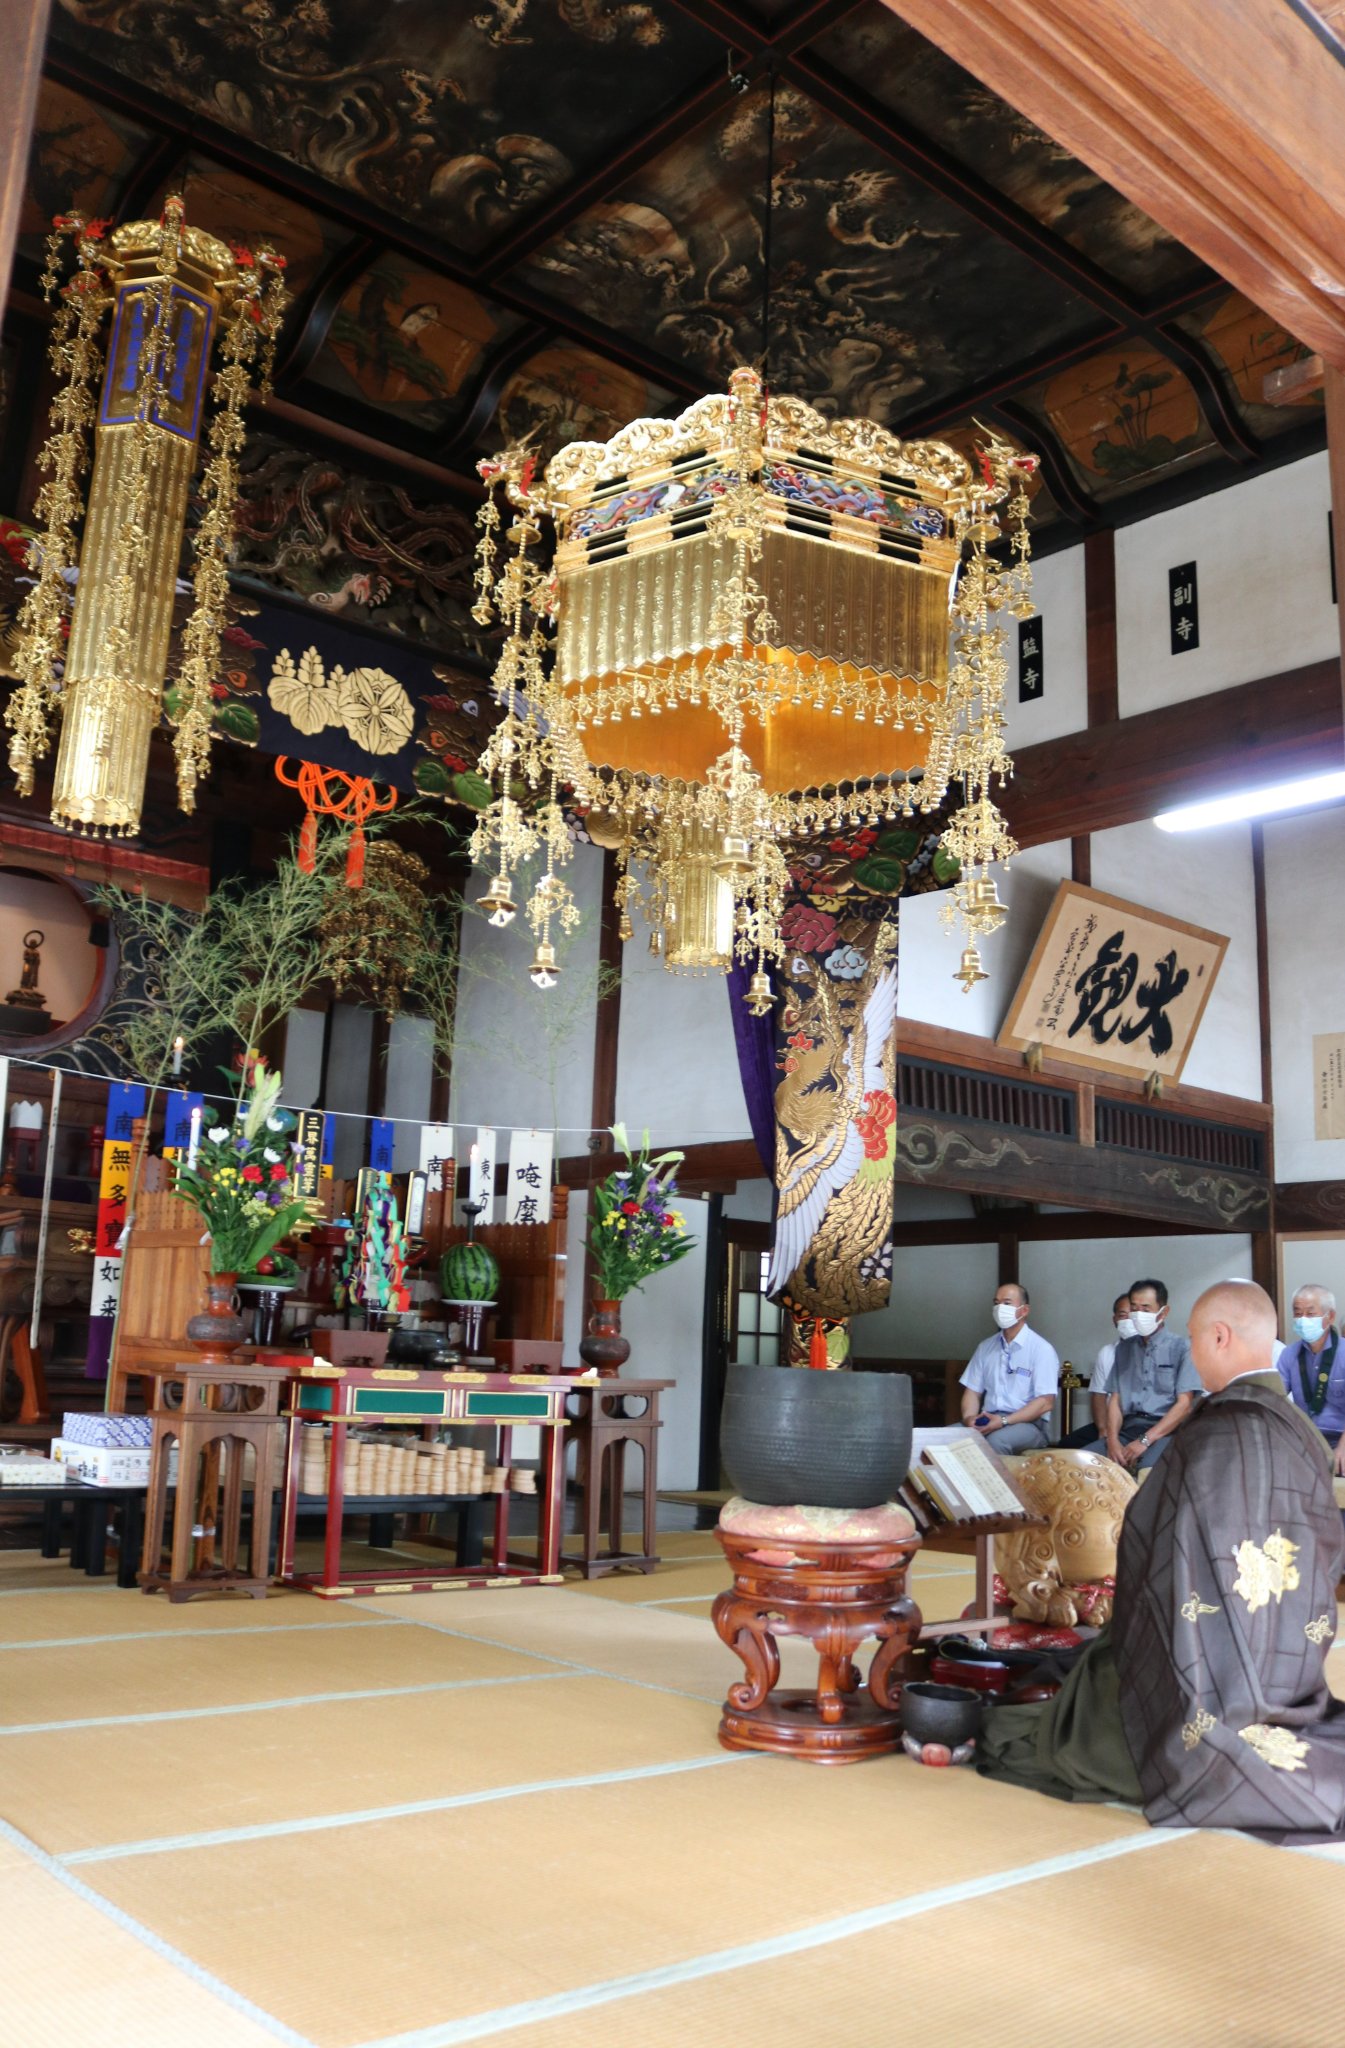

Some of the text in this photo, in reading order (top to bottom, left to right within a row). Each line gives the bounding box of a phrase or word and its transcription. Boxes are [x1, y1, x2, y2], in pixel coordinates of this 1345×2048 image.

[1173, 582, 1194, 641] 副寺
[1022, 636, 1040, 690] 監寺
[478, 1157, 492, 1225] 東方
